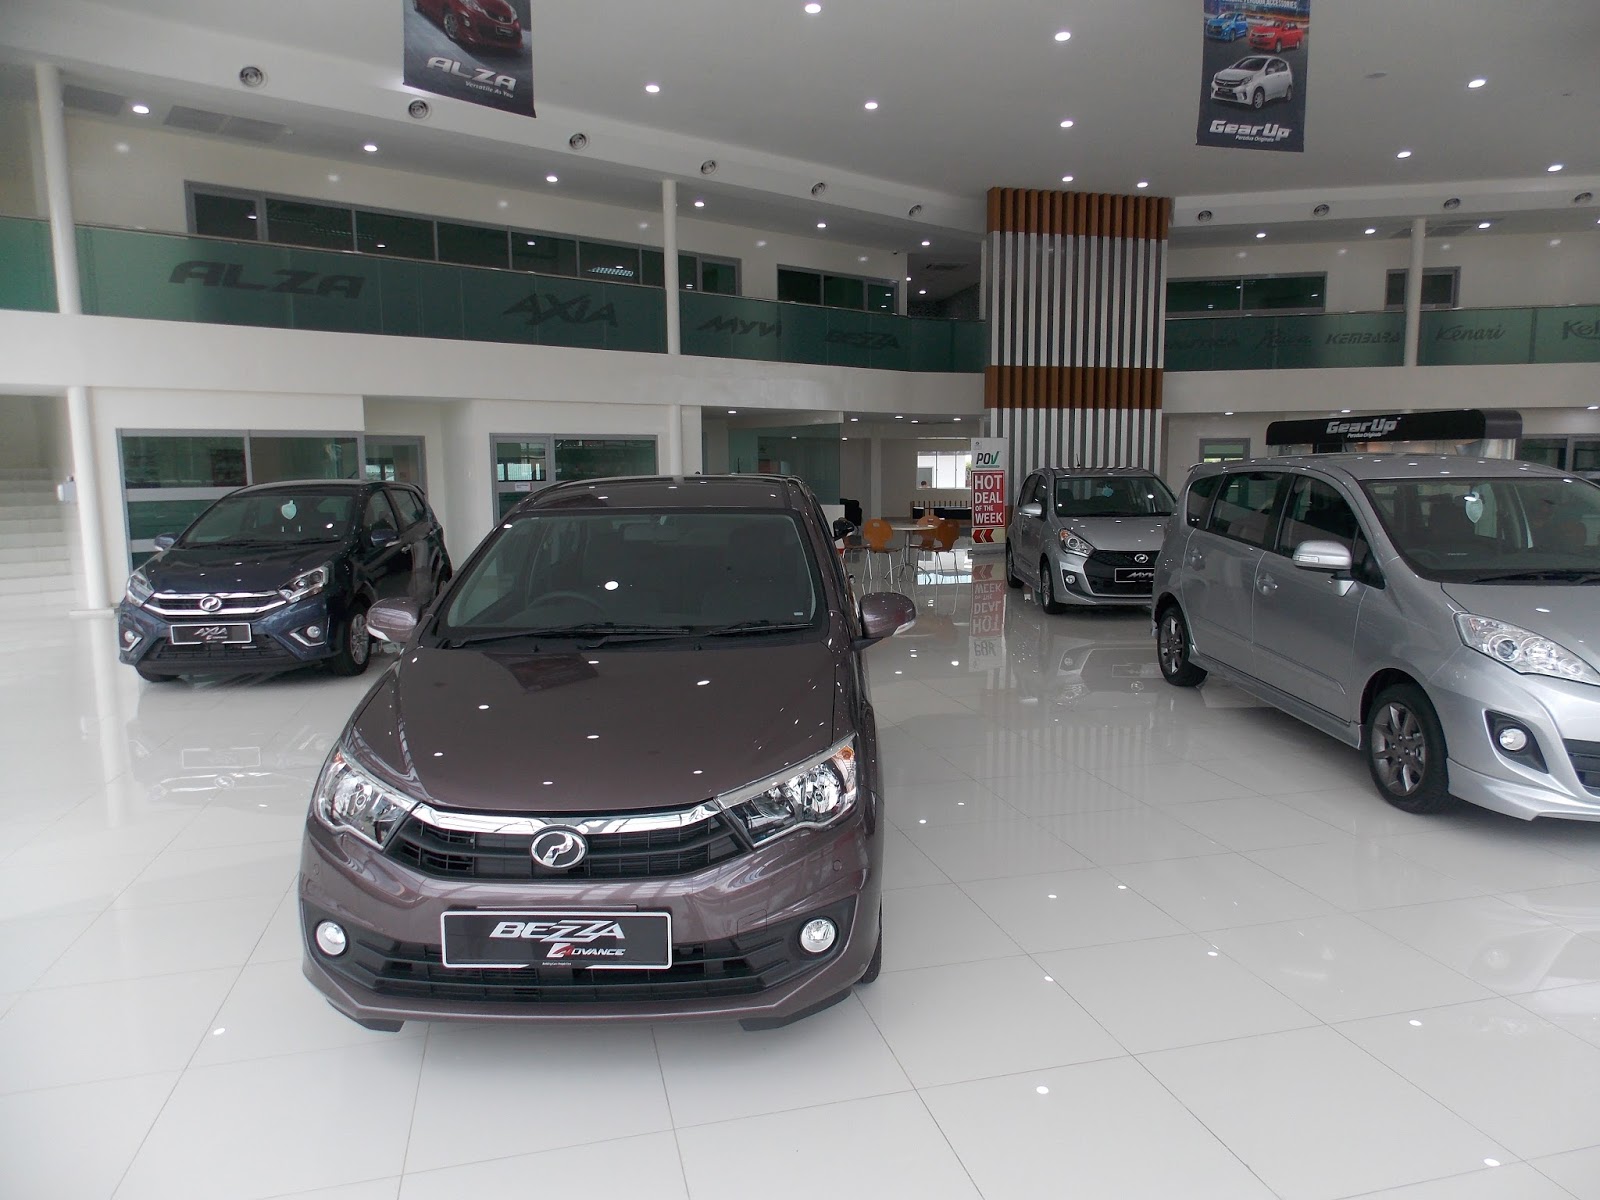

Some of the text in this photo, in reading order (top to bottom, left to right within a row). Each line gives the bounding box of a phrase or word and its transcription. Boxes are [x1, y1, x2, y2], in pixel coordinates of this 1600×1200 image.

[426, 56, 517, 92] ALZA
[465, 81, 493, 93] Versatile
[503, 91, 514, 99] You
[1209, 119, 1291, 141] GearUp
[168, 260, 366, 299] ALZA
[1325, 331, 1401, 346] KEMBARA
[1435, 324, 1508, 341] Kenari
[1326, 418, 1397, 435] GearUp
[974, 475, 1003, 490] HOT
[975, 492, 1003, 504] DEAL
[975, 512, 1003, 524] WEEK
[489, 919, 626, 943] BEZZA
[546, 942, 627, 958] ADVANCE
